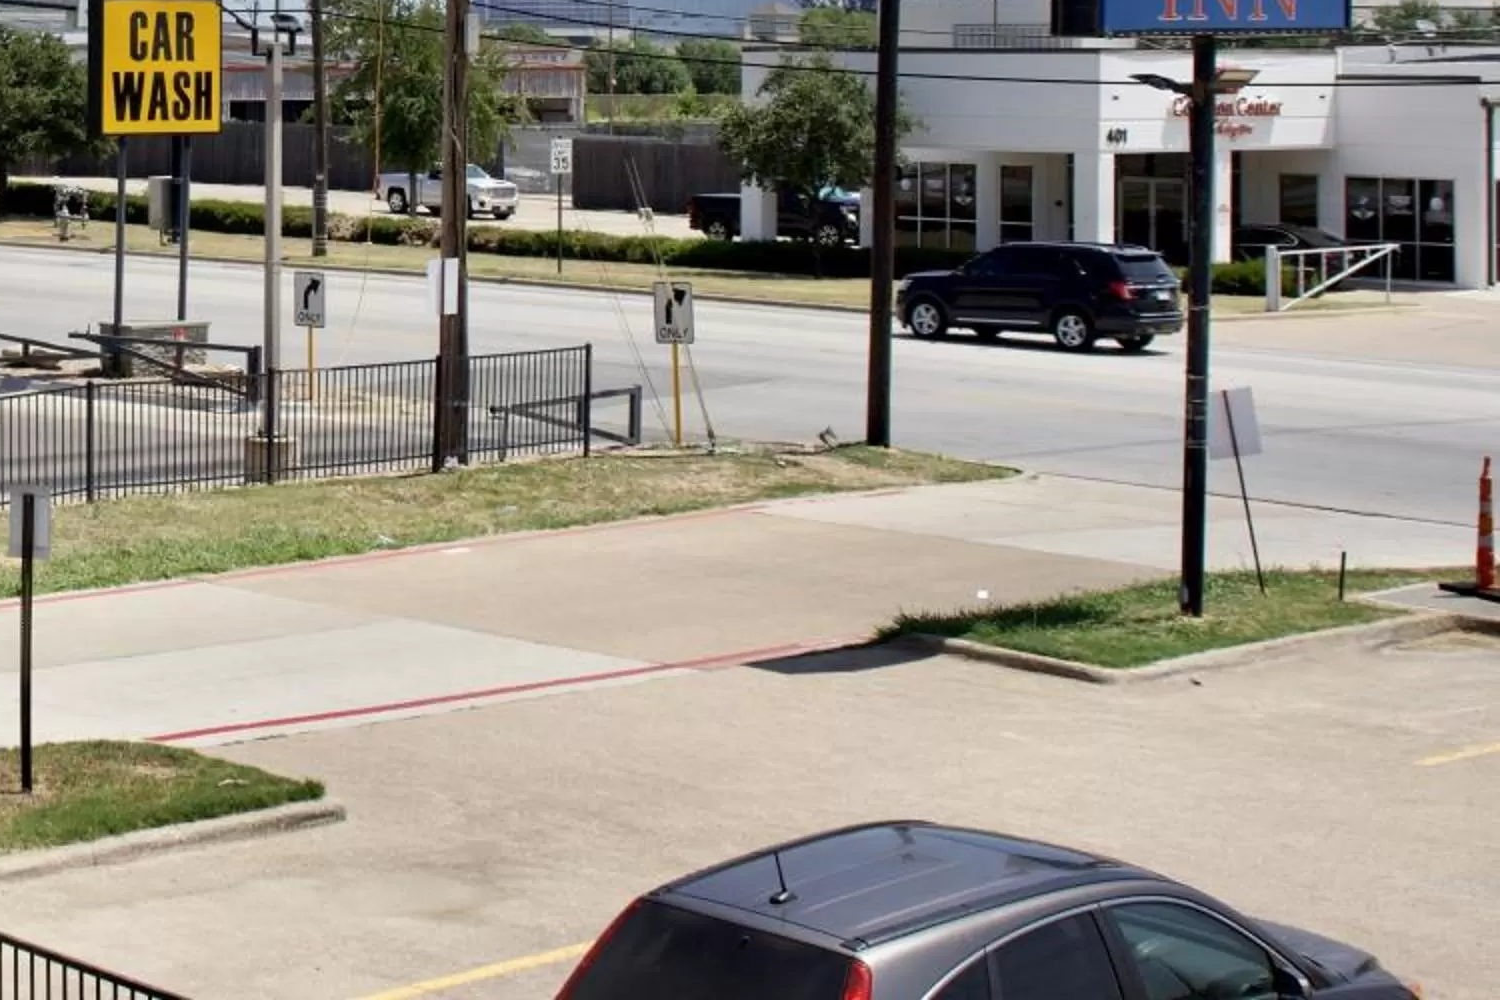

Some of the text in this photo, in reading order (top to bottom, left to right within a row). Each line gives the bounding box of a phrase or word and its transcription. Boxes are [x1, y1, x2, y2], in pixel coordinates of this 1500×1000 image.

[129, 10, 195, 62] CAR
[112, 71, 213, 122] WASH
[1236, 97, 1283, 117] Center
[1105, 127, 1127, 145] 401
[297, 311, 321, 323] ONLY
[660, 327, 689, 339] ONLY
